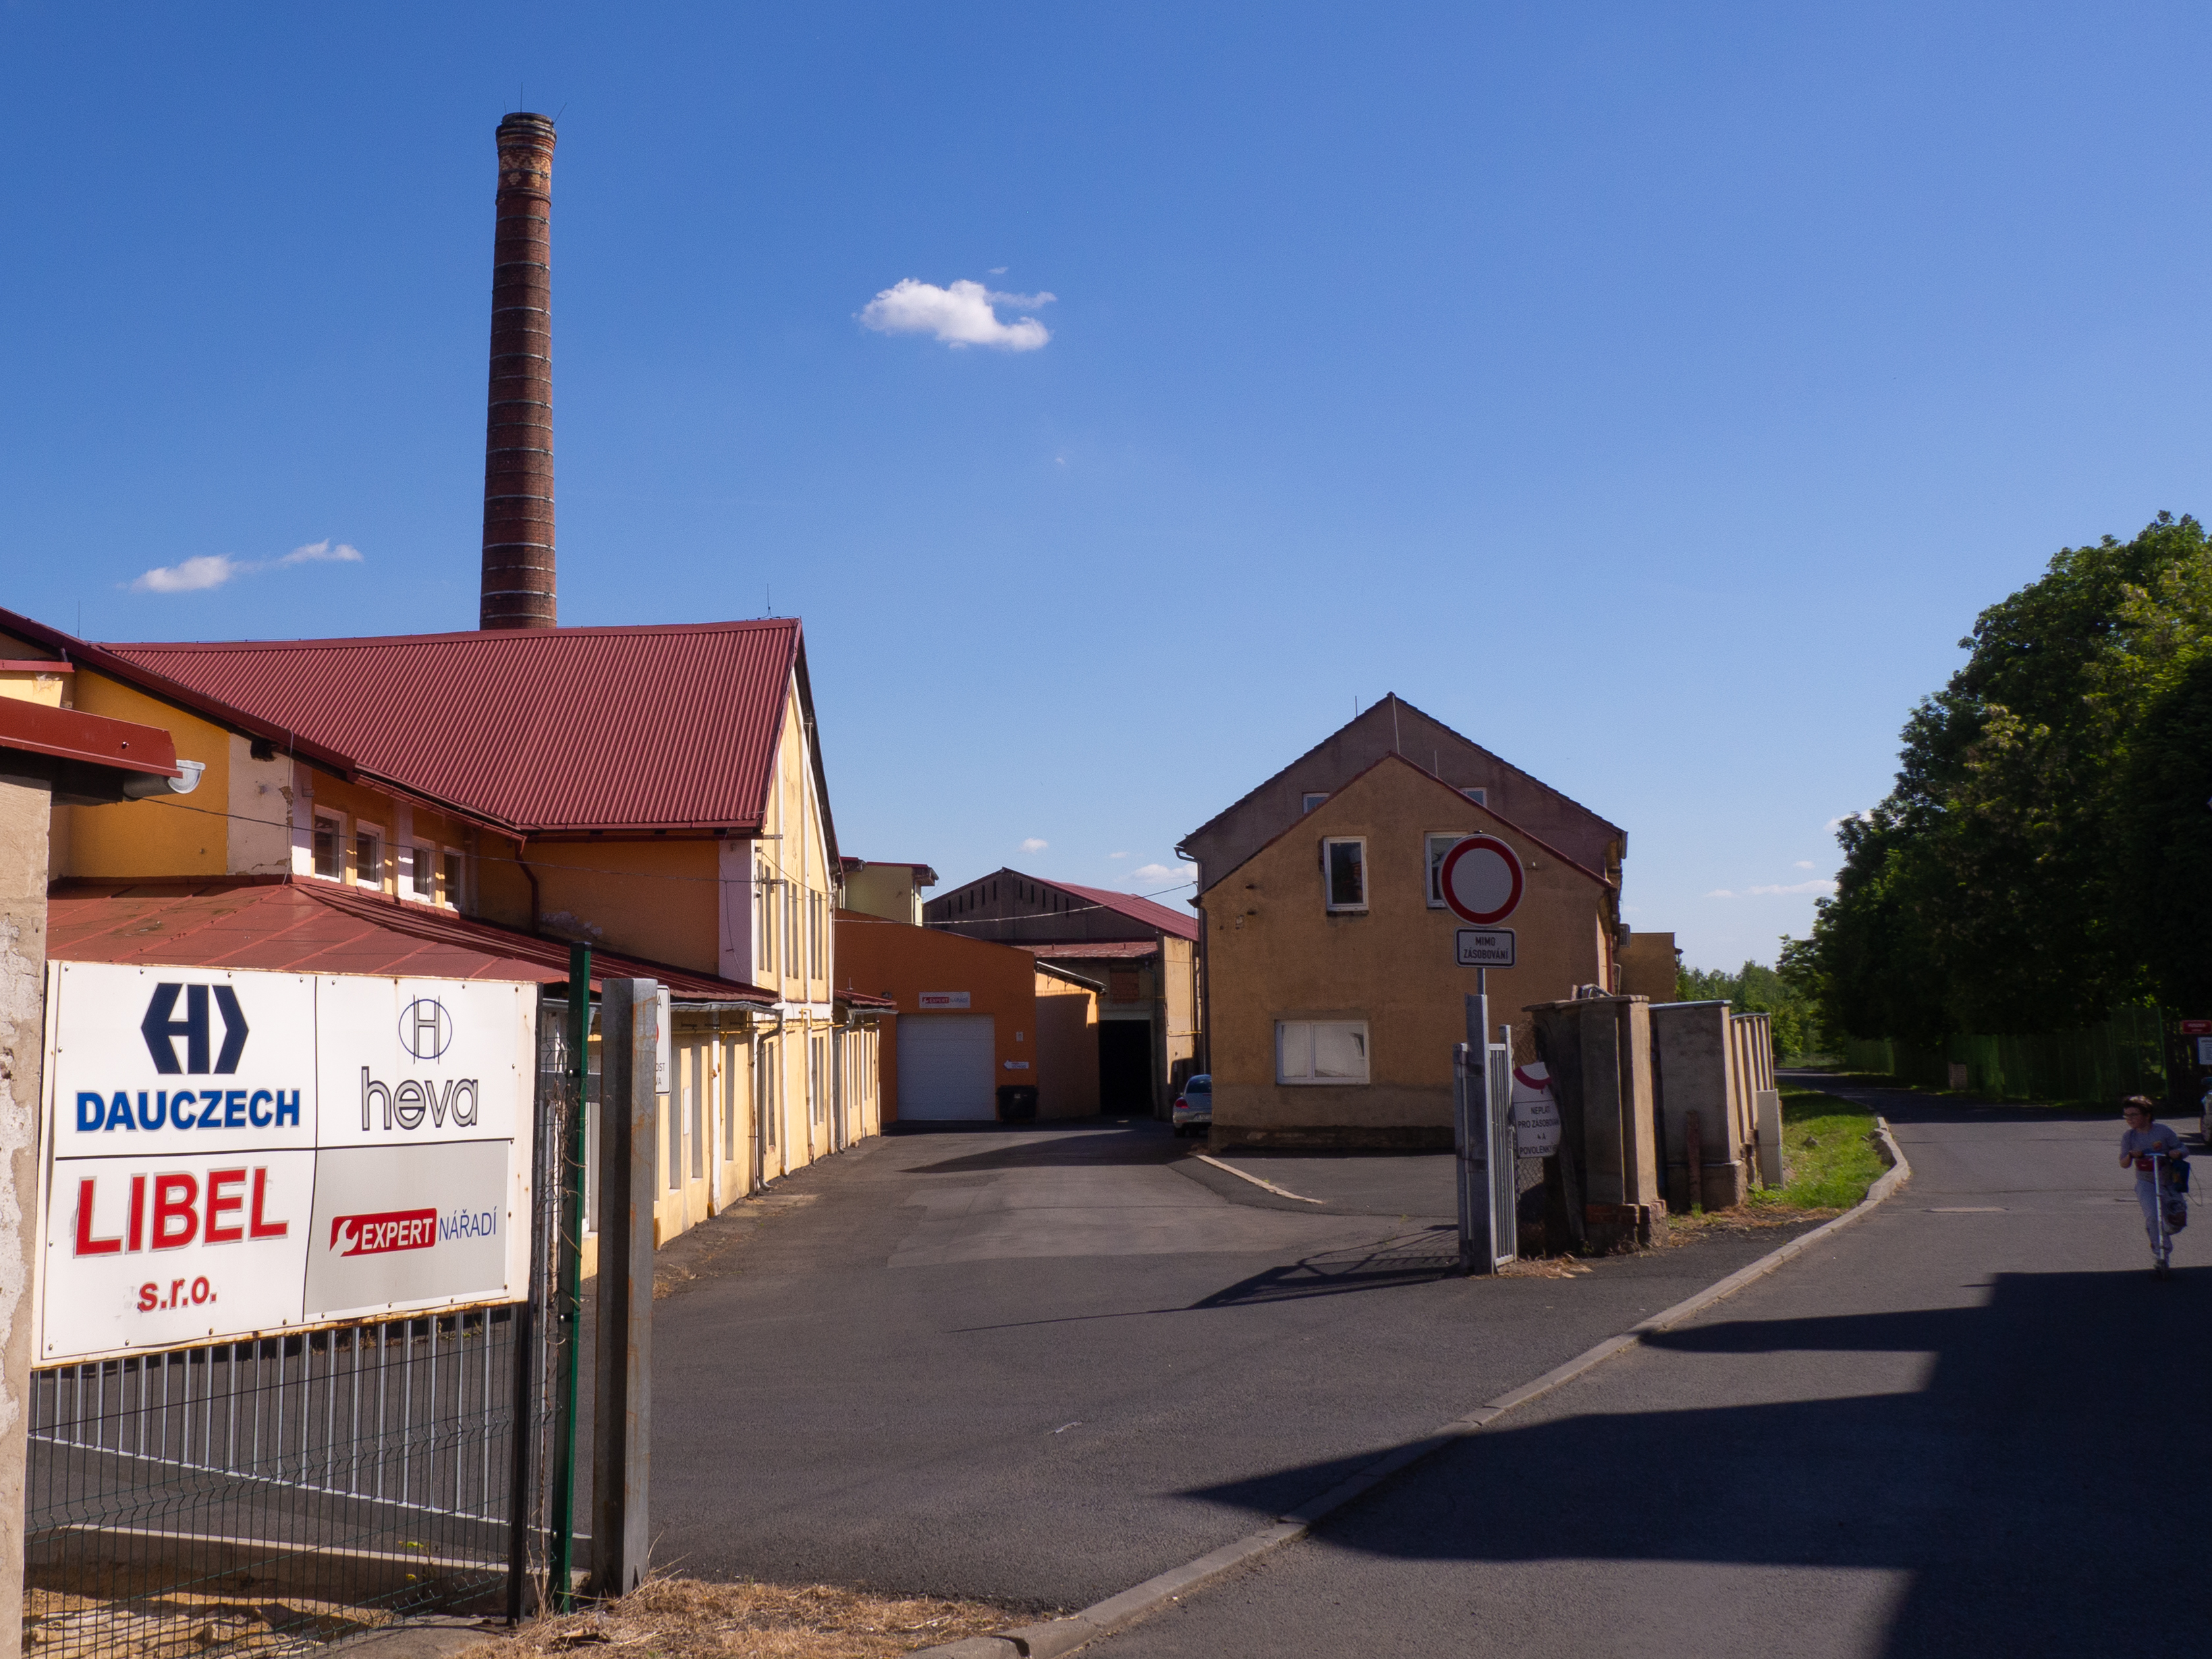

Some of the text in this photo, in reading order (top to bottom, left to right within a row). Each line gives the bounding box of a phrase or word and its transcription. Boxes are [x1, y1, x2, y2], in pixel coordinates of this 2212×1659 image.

[1463, 947, 1508, 959] ZÁSOBOVÁNÍ
[1476, 937, 1496, 946] MIMO
[76, 1089, 300, 1133] DAUCZECH
[362, 1066, 478, 1131] heva
[74, 1166, 289, 1257] LIBEL
[362, 1206, 497, 1250] EXPERT NÁŘADÍ
[138, 1276, 218, 1312] s.r.o.
